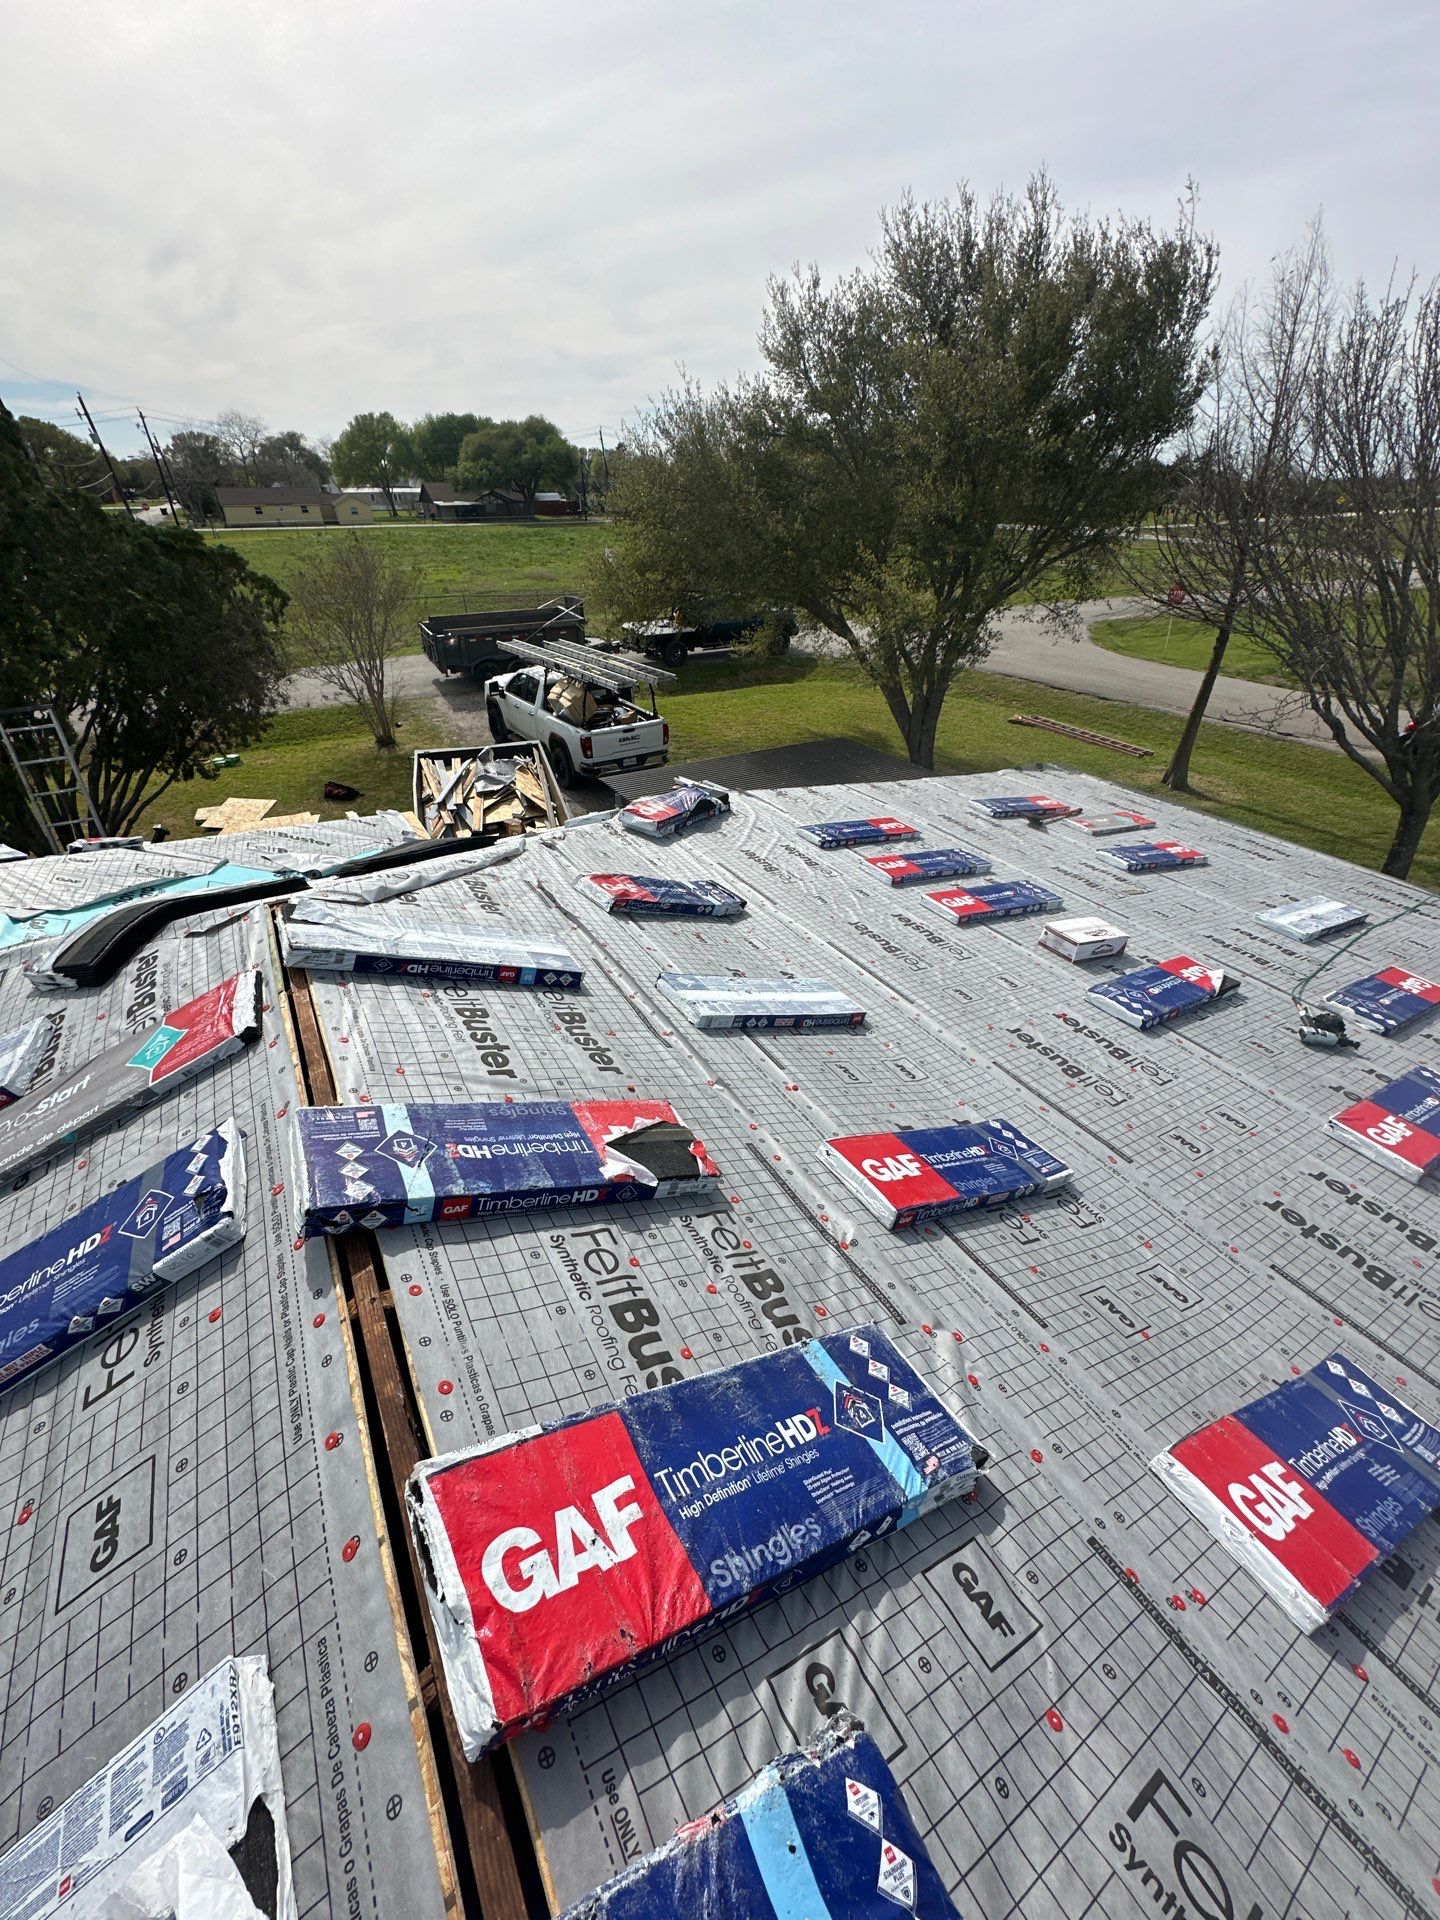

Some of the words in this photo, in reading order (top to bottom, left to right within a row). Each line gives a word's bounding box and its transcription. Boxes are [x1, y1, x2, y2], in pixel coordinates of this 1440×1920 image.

[618, 735, 640, 743] GMC
[876, 860, 908, 869] GAF
[941, 896, 975, 907] GAF
[847, 920, 928, 971] FeltBuster
[891, 913, 972, 961] FeltBuster
[543, 989, 624, 1075] eltBuster
[1006, 1027, 1128, 1107] FeltBuster
[489, 1104, 567, 1118] Shingles
[1216, 1110, 1247, 1130] GAF
[37, 1131, 54, 1145] de
[1170, 1133, 1201, 1154] GAF
[861, 1154, 923, 1182] GAF
[953, 1176, 998, 1191] Shingles
[444, 1204, 469, 1215] GAF
[477, 1187, 608, 1212] TimberlineHDZ
[275, 1256, 286, 1282] Staples
[277, 1281, 288, 1295] Cap
[680, 1215, 724, 1274] Synthetic
[721, 1275, 763, 1330] Roofing
[278, 1294, 290, 1319] Plastic
[550, 1234, 592, 1301] Synthetic
[586, 1304, 627, 1371] Roofing
[1149, 1274, 1189, 1304] GAF
[1094, 1295, 1136, 1329] GAF
[283, 1327, 293, 1350] Nails
[424, 1237, 434, 1251] Cap
[429, 1249, 442, 1276] Staples
[440, 1283, 450, 1298] Use
[479, 1403, 496, 1437] Grapas
[285, 1348, 296, 1367] Cap
[287, 1366, 298, 1396] Plastic
[289, 1398, 300, 1424] ONLY
[654, 1406, 832, 1502] TimberlineHDZ
[1114, 1432, 1133, 1451] Nails
[679, 1500, 705, 1520] High
[705, 1477, 751, 1503] Definition
[751, 1462, 786, 1485] Lifetime
[785, 1449, 820, 1469] Shingles
[1227, 1461, 1315, 1541] GAF
[90, 1494, 122, 1573] GAF
[1355, 1496, 1404, 1539] Shingles
[481, 1475, 644, 1613] GAF
[710, 1517, 822, 1588] Shingles
[952, 1562, 1015, 1638] GAF
[318, 1636, 332, 1699] Plástica
[1094, 1543, 1128, 1582] FIELTRO
[1183, 1649, 1211, 1680] PARA
[1268, 1743, 1298, 1778] CON
[325, 1697, 340, 1760] Cabeza
[1371, 1693, 1415, 1742] Plástica
[332, 1760, 345, 1789] De
[335, 1787, 352, 1858] Grapas
[601, 1767, 619, 1807] Use
[614, 1804, 642, 1860] ONLY
